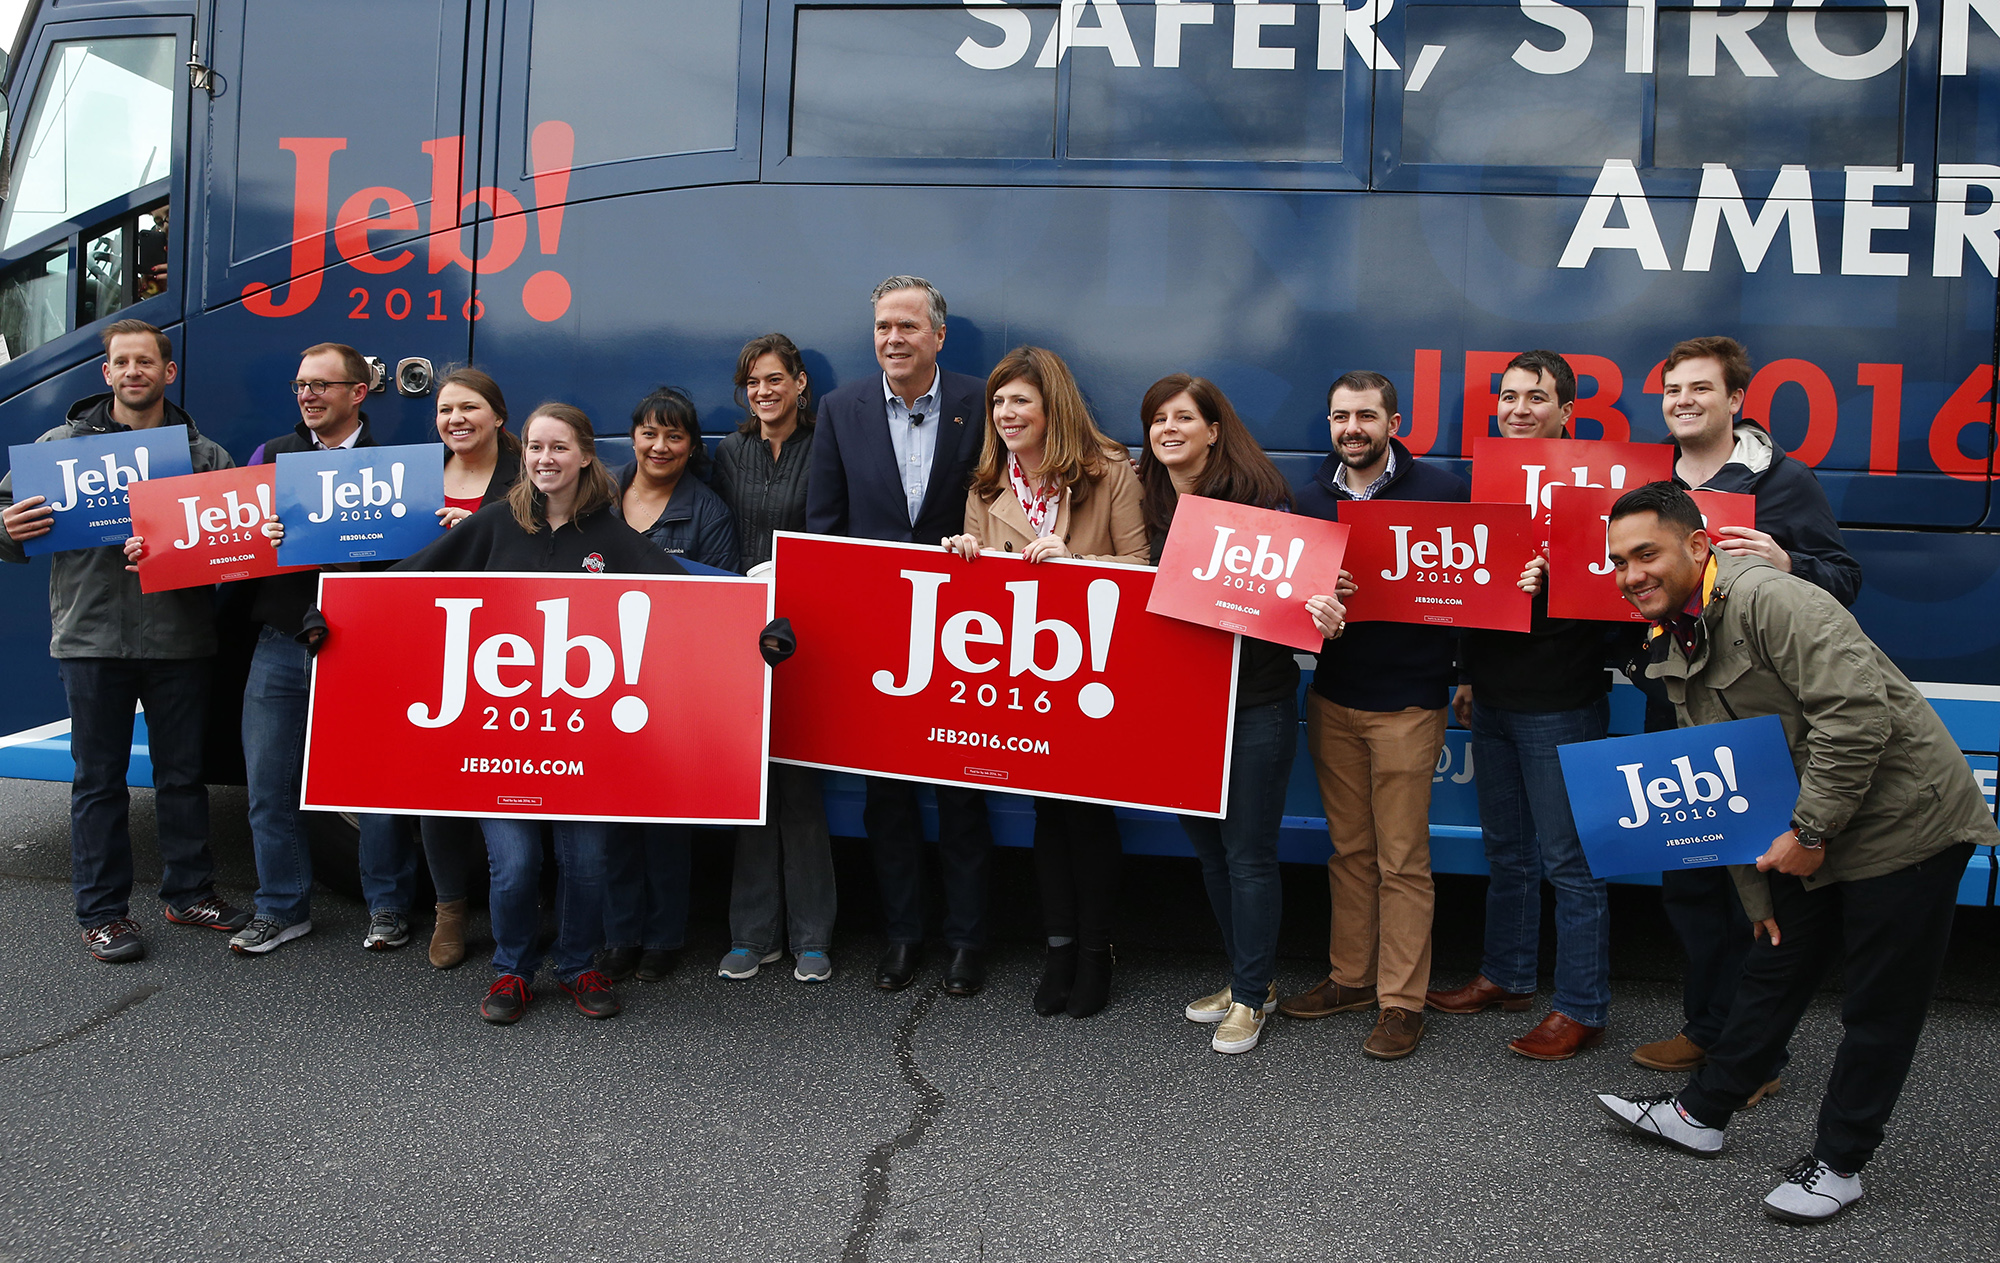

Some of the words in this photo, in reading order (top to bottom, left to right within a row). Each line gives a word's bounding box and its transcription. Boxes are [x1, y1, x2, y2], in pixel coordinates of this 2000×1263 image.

[955, 0, 1447, 92] SAFER,
[241, 120, 575, 322] Jeb!
[1556, 158, 2000, 278] AMER
[348, 287, 486, 322] 2016
[1400, 349, 2000, 482] JEB016
[307, 461, 407, 523] Jeb!
[173, 483, 271, 550] Jeb!
[340, 509, 383, 522] 2016
[207, 531, 253, 546] 2016
[339, 532, 384, 542] JEB2016.COM
[209, 553, 256, 566] JEB2016.COM
[1191, 525, 1305, 599] Jeb!
[1380, 523, 1491, 585] Jeb!
[1222, 575, 1267, 595] 2016
[1416, 571, 1463, 585] 2016
[1214, 599, 1261, 617] JEB2016.COM
[1414, 596, 1463, 606] JEB2016.COM
[871, 569, 1120, 720] Jeb!
[406, 590, 652, 734] Jeb!
[949, 680, 1052, 714] 2016
[482, 706, 586, 733] 2016
[927, 726, 1051, 756] JEB2016.COM
[460, 756, 585, 777] JEB2016.COM
[1616, 746, 1749, 829] Jeb!
[1659, 806, 1717, 825] 2016
[1665, 833, 1725, 847] JEB2016.COM
